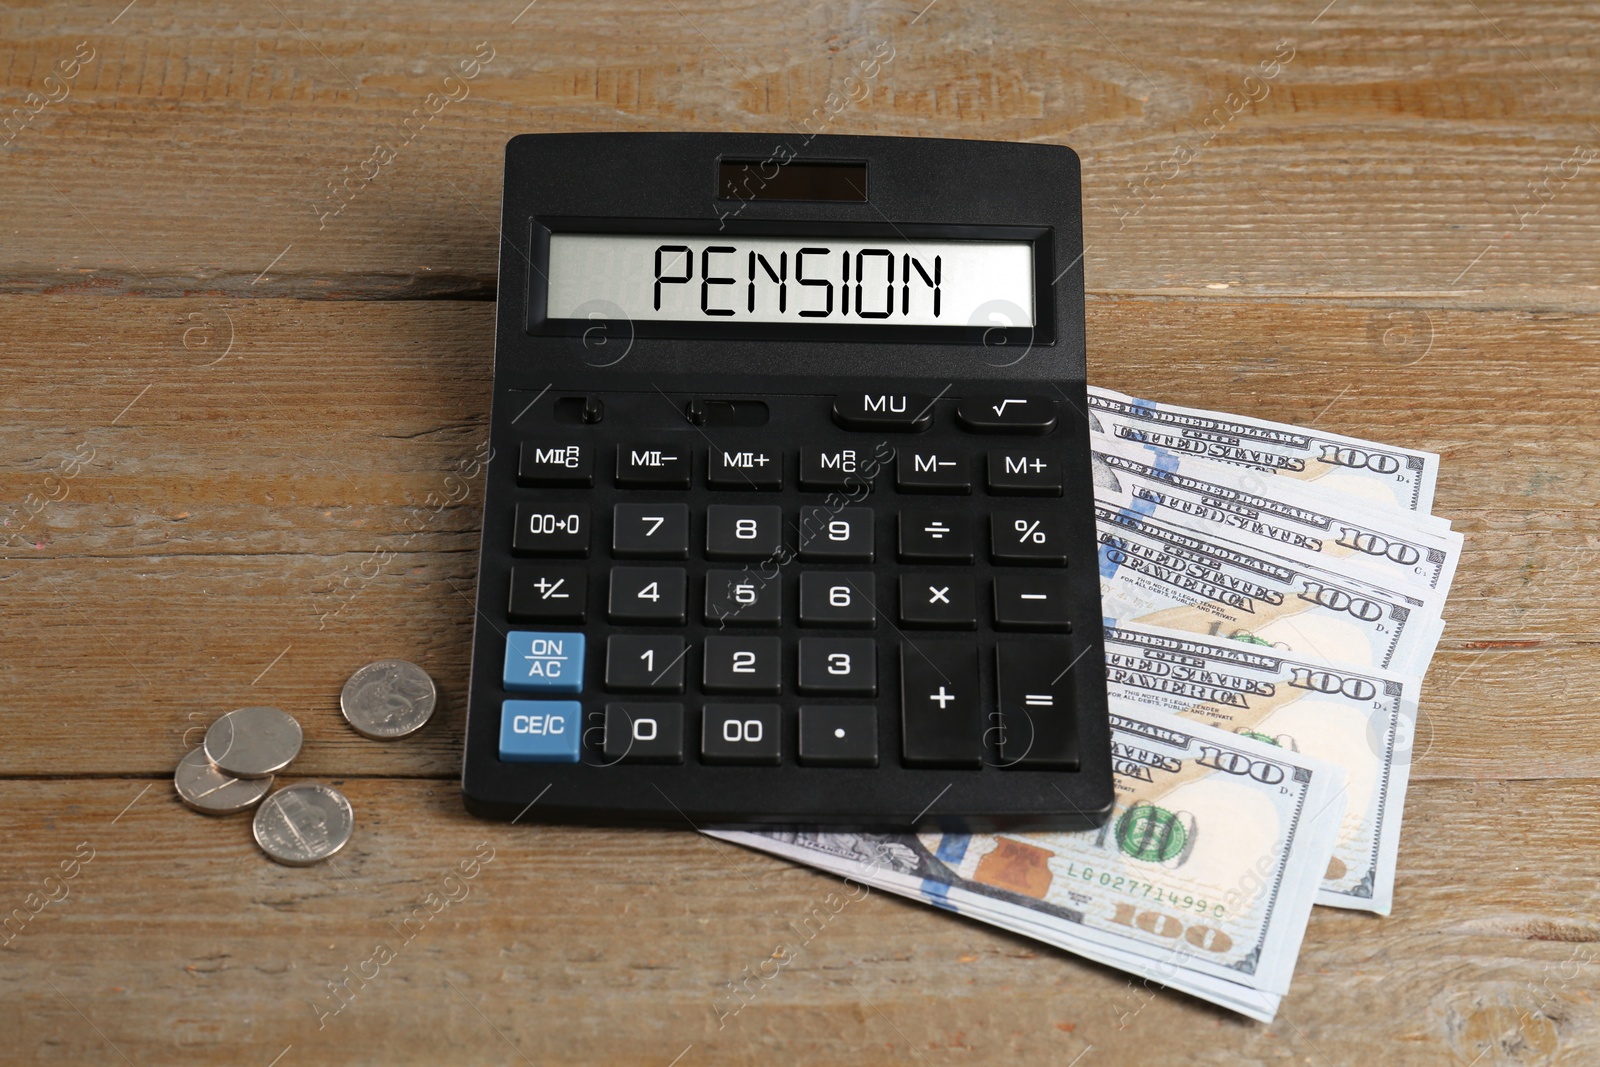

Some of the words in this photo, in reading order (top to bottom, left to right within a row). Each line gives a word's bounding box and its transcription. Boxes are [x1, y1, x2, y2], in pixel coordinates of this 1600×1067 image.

[653, 244, 942, 320] PENSION
[863, 394, 908, 413] MU
[1218, 421, 1305, 445] DOLLARS
[1005, 456, 1047, 475] M+
[1208, 443, 1306, 472] STATES
[1316, 444, 1400, 475] 100
[1239, 494, 1327, 525] DOLLARS
[641, 516, 665, 538] 7
[735, 519, 757, 539] 8
[828, 521, 850, 541] 9
[1014, 519, 1046, 544] %
[1224, 513, 1323, 553] STATES
[1335, 527, 1420, 566] 100
[1201, 543, 1290, 578] DOLLARS
[636, 582, 660, 602] 4
[735, 584, 756, 604] 5
[829, 586, 850, 607] 6
[1136, 576, 1152, 586] THIS
[1152, 583, 1170, 593] NOTE
[1178, 592, 1199, 604] LEGAL
[1199, 600, 1226, 613] TENDER
[1137, 562, 1256, 615] AMERICA
[1185, 563, 1285, 606] STATES
[1120, 575, 1134, 585] FOR
[1134, 580, 1147, 590] ALL
[1171, 595, 1196, 608] PUBLIC
[1196, 603, 1210, 613] AND
[1211, 609, 1238, 623] PRIVATE
[1297, 580, 1383, 622] 100
[530, 639, 564, 655] ON
[1182, 643, 1276, 669] DOLLARS
[528, 661, 562, 678] AC
[641, 650, 654, 671] 1
[732, 652, 757, 673] 2
[827, 653, 851, 675] 3
[1123, 673, 1250, 710] AMERICA
[1171, 665, 1276, 697] STATES
[1287, 667, 1377, 701] 100
[1124, 689, 1140, 697] THIS
[1141, 692, 1160, 701] NOTE
[1169, 697, 1191, 708] LEGAL
[1192, 703, 1220, 713] TENDER
[1163, 702, 1190, 714] PUBLIC
[1191, 708, 1206, 716] AND
[1206, 710, 1234, 722] PRIVATE
[512, 714, 565, 735] CE/C
[633, 718, 657, 741] 0
[722, 719, 763, 742] 00
[1194, 745, 1285, 785] 100
[1099, 872, 1208, 914] 02771499
[1104, 901, 1234, 954] 100
